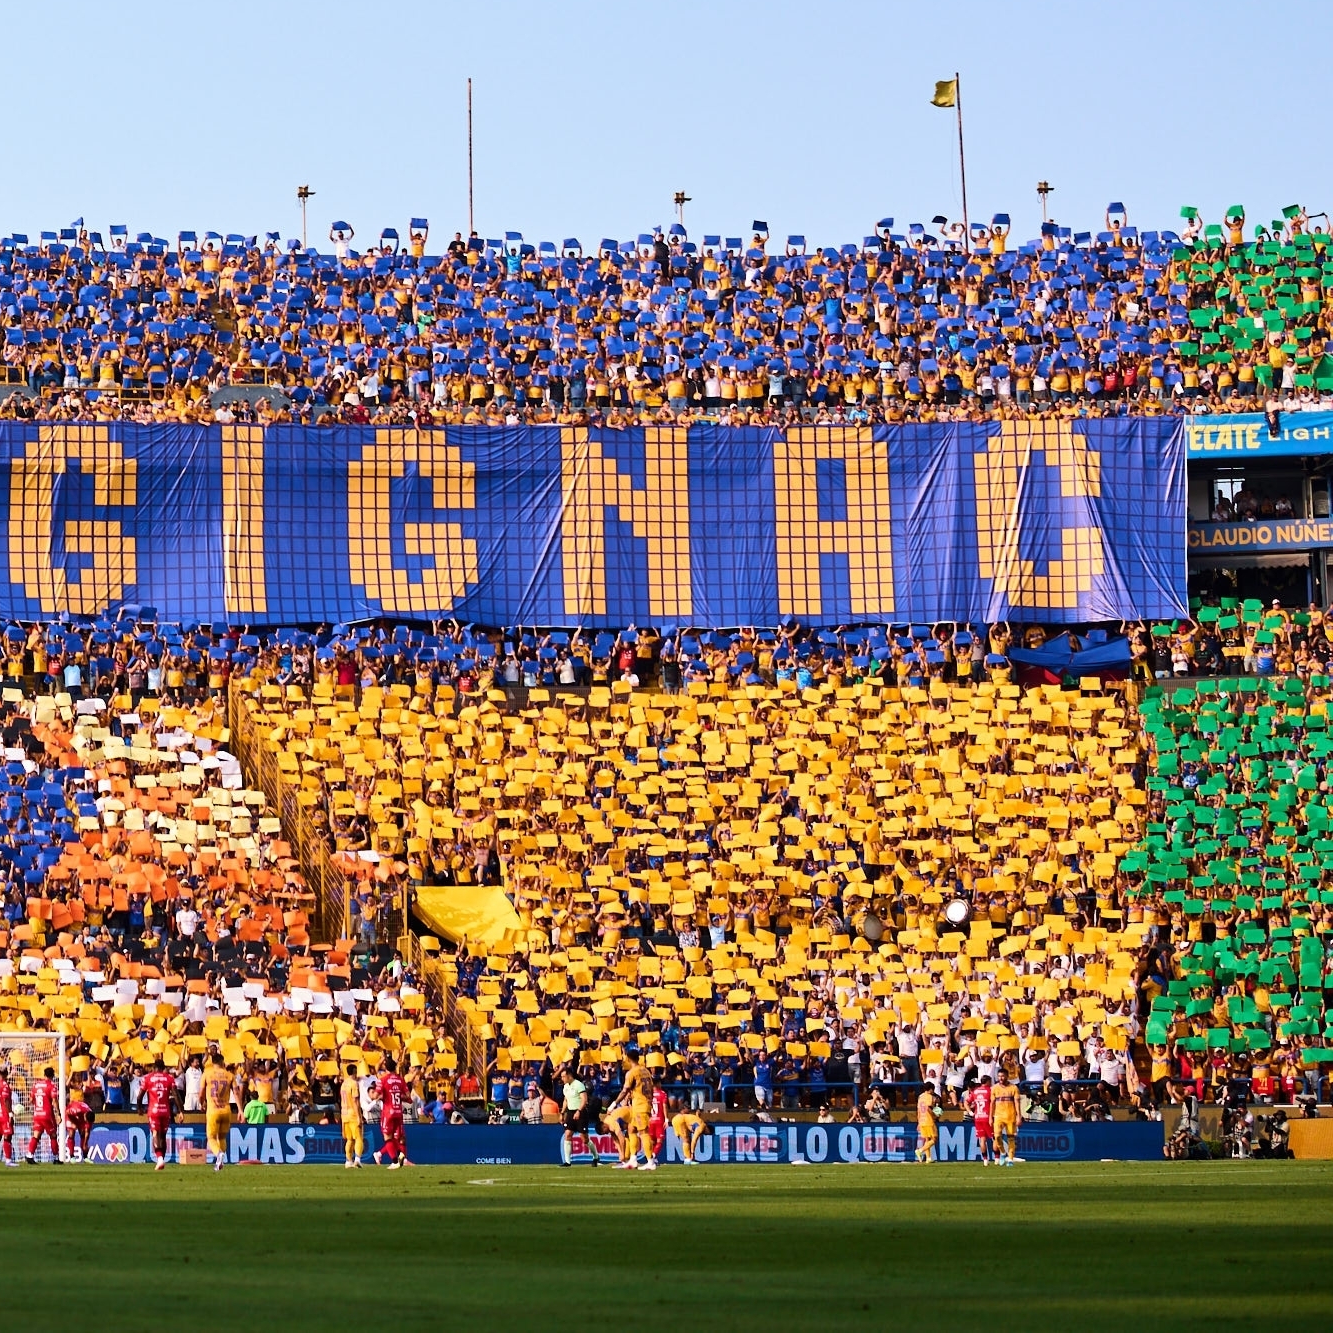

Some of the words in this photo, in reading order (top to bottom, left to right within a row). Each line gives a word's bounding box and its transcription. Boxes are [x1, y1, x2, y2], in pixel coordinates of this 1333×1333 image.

[1186, 423, 1264, 451] ECATE
[1268, 427, 1333, 441] LIGH
[8, 420, 1104, 615] GIGNAC
[1188, 526, 1273, 547] CLAUDIO
[210, 1080, 228, 1098] 27
[390, 1092, 401, 1105] 15
[208, 1127, 306, 1163] MAS
[788, 1126, 829, 1161] LO
[838, 1126, 905, 1162] QUE
